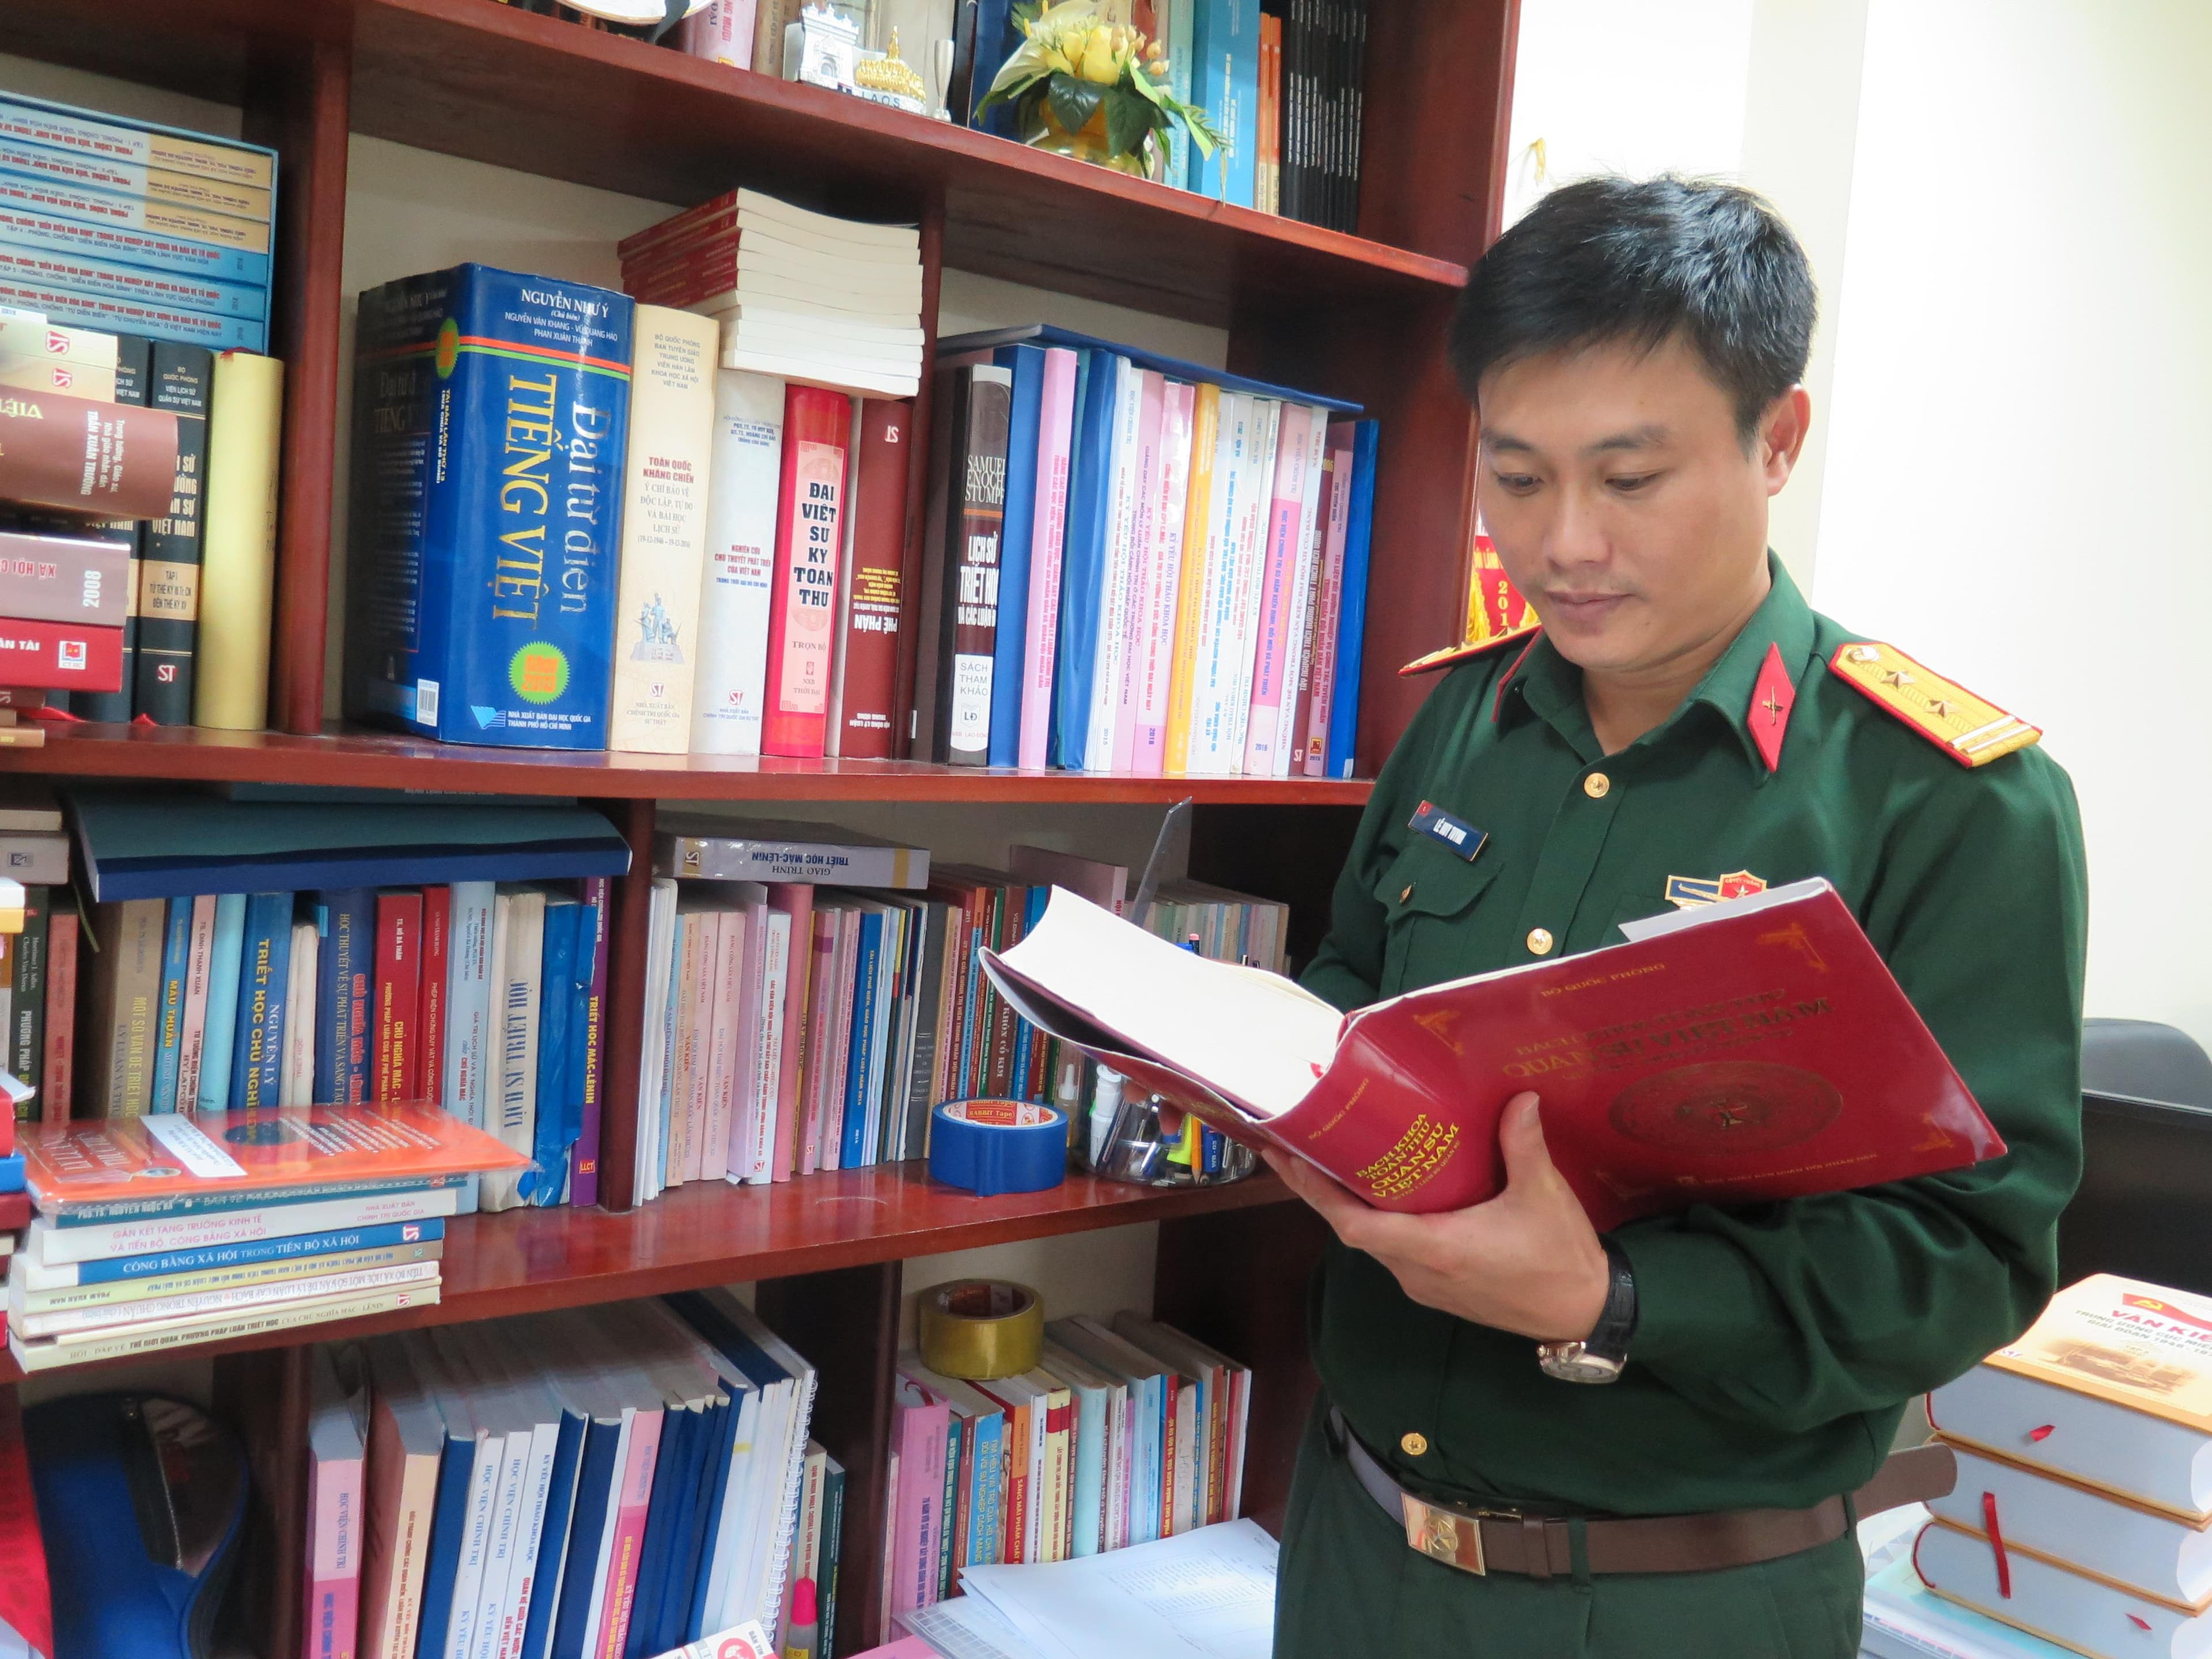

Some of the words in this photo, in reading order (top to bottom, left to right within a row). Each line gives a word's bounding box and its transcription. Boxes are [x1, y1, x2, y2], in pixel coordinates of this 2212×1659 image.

[521, 289, 571, 309] NGUYỄN
[548, 321, 570, 331] KHANG
[501, 374, 564, 517] TIẾNG
[564, 400, 612, 474] Đại
[183, 453, 196, 473] SỬ
[649, 456, 671, 468] TOÀN
[672, 458, 692, 471] QUỐC
[643, 468, 671, 480] KHÁNG
[967, 469, 1004, 488] ENOCH
[809, 482, 834, 503] ĐẠI
[802, 501, 836, 524] VIỆT
[175, 519, 195, 537] NAM
[809, 522, 830, 544] SỬ
[967, 536, 986, 566] LỊCH
[986, 531, 998, 564] SỬ
[487, 525, 551, 631] VIỆT
[794, 565, 834, 587] TOÀN
[960, 562, 986, 605] TRIẾT
[985, 567, 999, 608] HỌ
[82, 570, 101, 608] 2008
[799, 588, 829, 608] THƯ
[854, 614, 881, 633] PHÁN
[883, 616, 897, 635] PHÊ
[1162, 604, 1171, 627] KHOA
[18, 638, 40, 652] TÀI
[792, 641, 817, 652] TRỌN
[817, 640, 827, 652] BỘ
[157, 665, 177, 683] ST
[960, 662, 988, 672] SÁCH
[960, 674, 988, 684] THAM
[651, 682, 664, 698] ST
[729, 690, 744, 706] ST
[960, 684, 988, 696] KHẢO
[806, 853, 824, 865] HỌC
[825, 855, 846, 869] TRIẾT
[772, 865, 804, 875] TRÌNH
[806, 866, 831, 876] GIÁO
[255, 939, 274, 985] TRIẾT
[508, 980, 532, 1009] HỌC
[251, 990, 266, 1024] HỌC
[588, 996, 600, 1024] TRIẾT
[265, 1005, 280, 1063] NGUYÊN
[394, 1021, 407, 1039] CHỦ
[503, 1015, 529, 1065] TRIẾT
[586, 1025, 597, 1046] HỌC
[249, 1028, 264, 1061] CHỦ
[393, 1041, 404, 1067] NGHĨA
[263, 1067, 278, 1086] LÝ
[392, 1070, 404, 1089] MÁC
[585, 1048, 599, 1104] MÁC-LÊNIN
[503, 1093, 528, 1130] LỊCH
[1394, 1113, 1427, 1152] KHOA
[1422, 1123, 1460, 1171] NAM
[579, 1161, 594, 1172] LLCT
[228, 1216, 250, 1226] KINH
[123, 1259, 157, 1274] CÔNG
[198, 1251, 214, 1264] XÃ
[217, 1249, 237, 1262] HỘI
[240, 1246, 274, 1258] TRONG
[276, 1240, 302, 1254] TIẾN
[304, 1238, 320, 1251] BỘ
[322, 1236, 338, 1248] XÃ
[340, 1234, 359, 1247] HỘI
[2112, 1309, 2164, 1328] VĂN
[482, 1464, 494, 1486] HỌC
[1016, 1479, 1025, 1500] SÁNG
[479, 1488, 490, 1512] VIỆN
[472, 1514, 486, 1547] CHÍNH
[468, 1550, 480, 1566] TRỊ
[521, 1577, 531, 1594] QUAN
